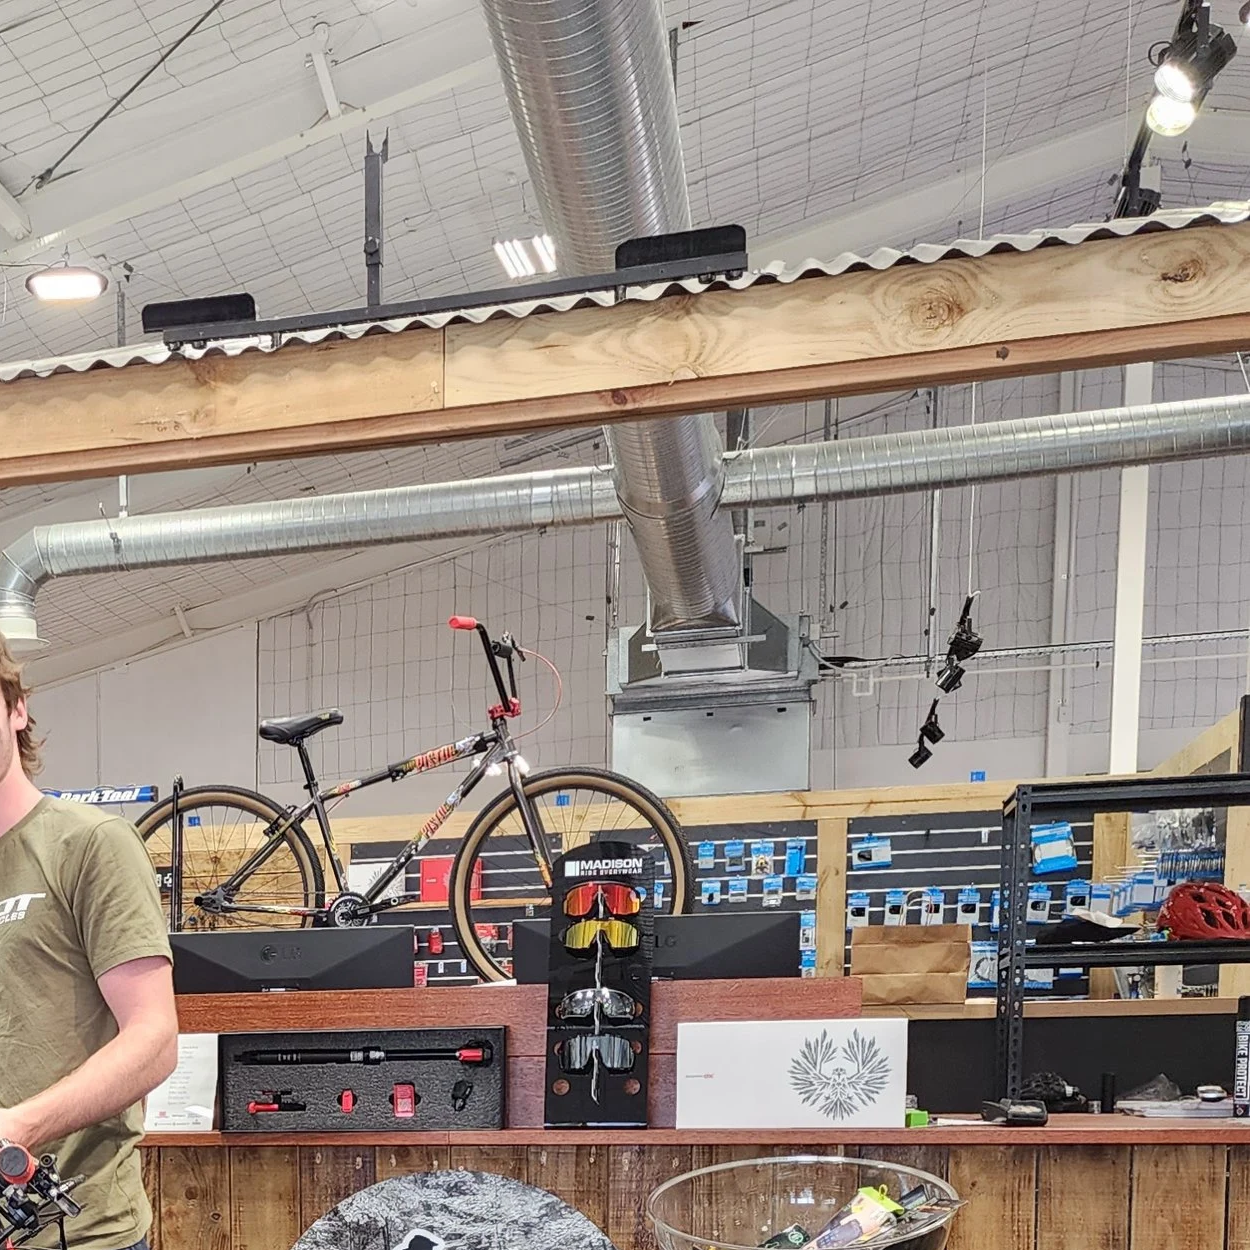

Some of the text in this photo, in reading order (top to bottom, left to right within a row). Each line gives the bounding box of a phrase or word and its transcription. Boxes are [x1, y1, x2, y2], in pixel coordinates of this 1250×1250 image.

[580, 858, 643, 870] MADISON
[1236, 1034, 1249, 1099] BIKE PROTECT
